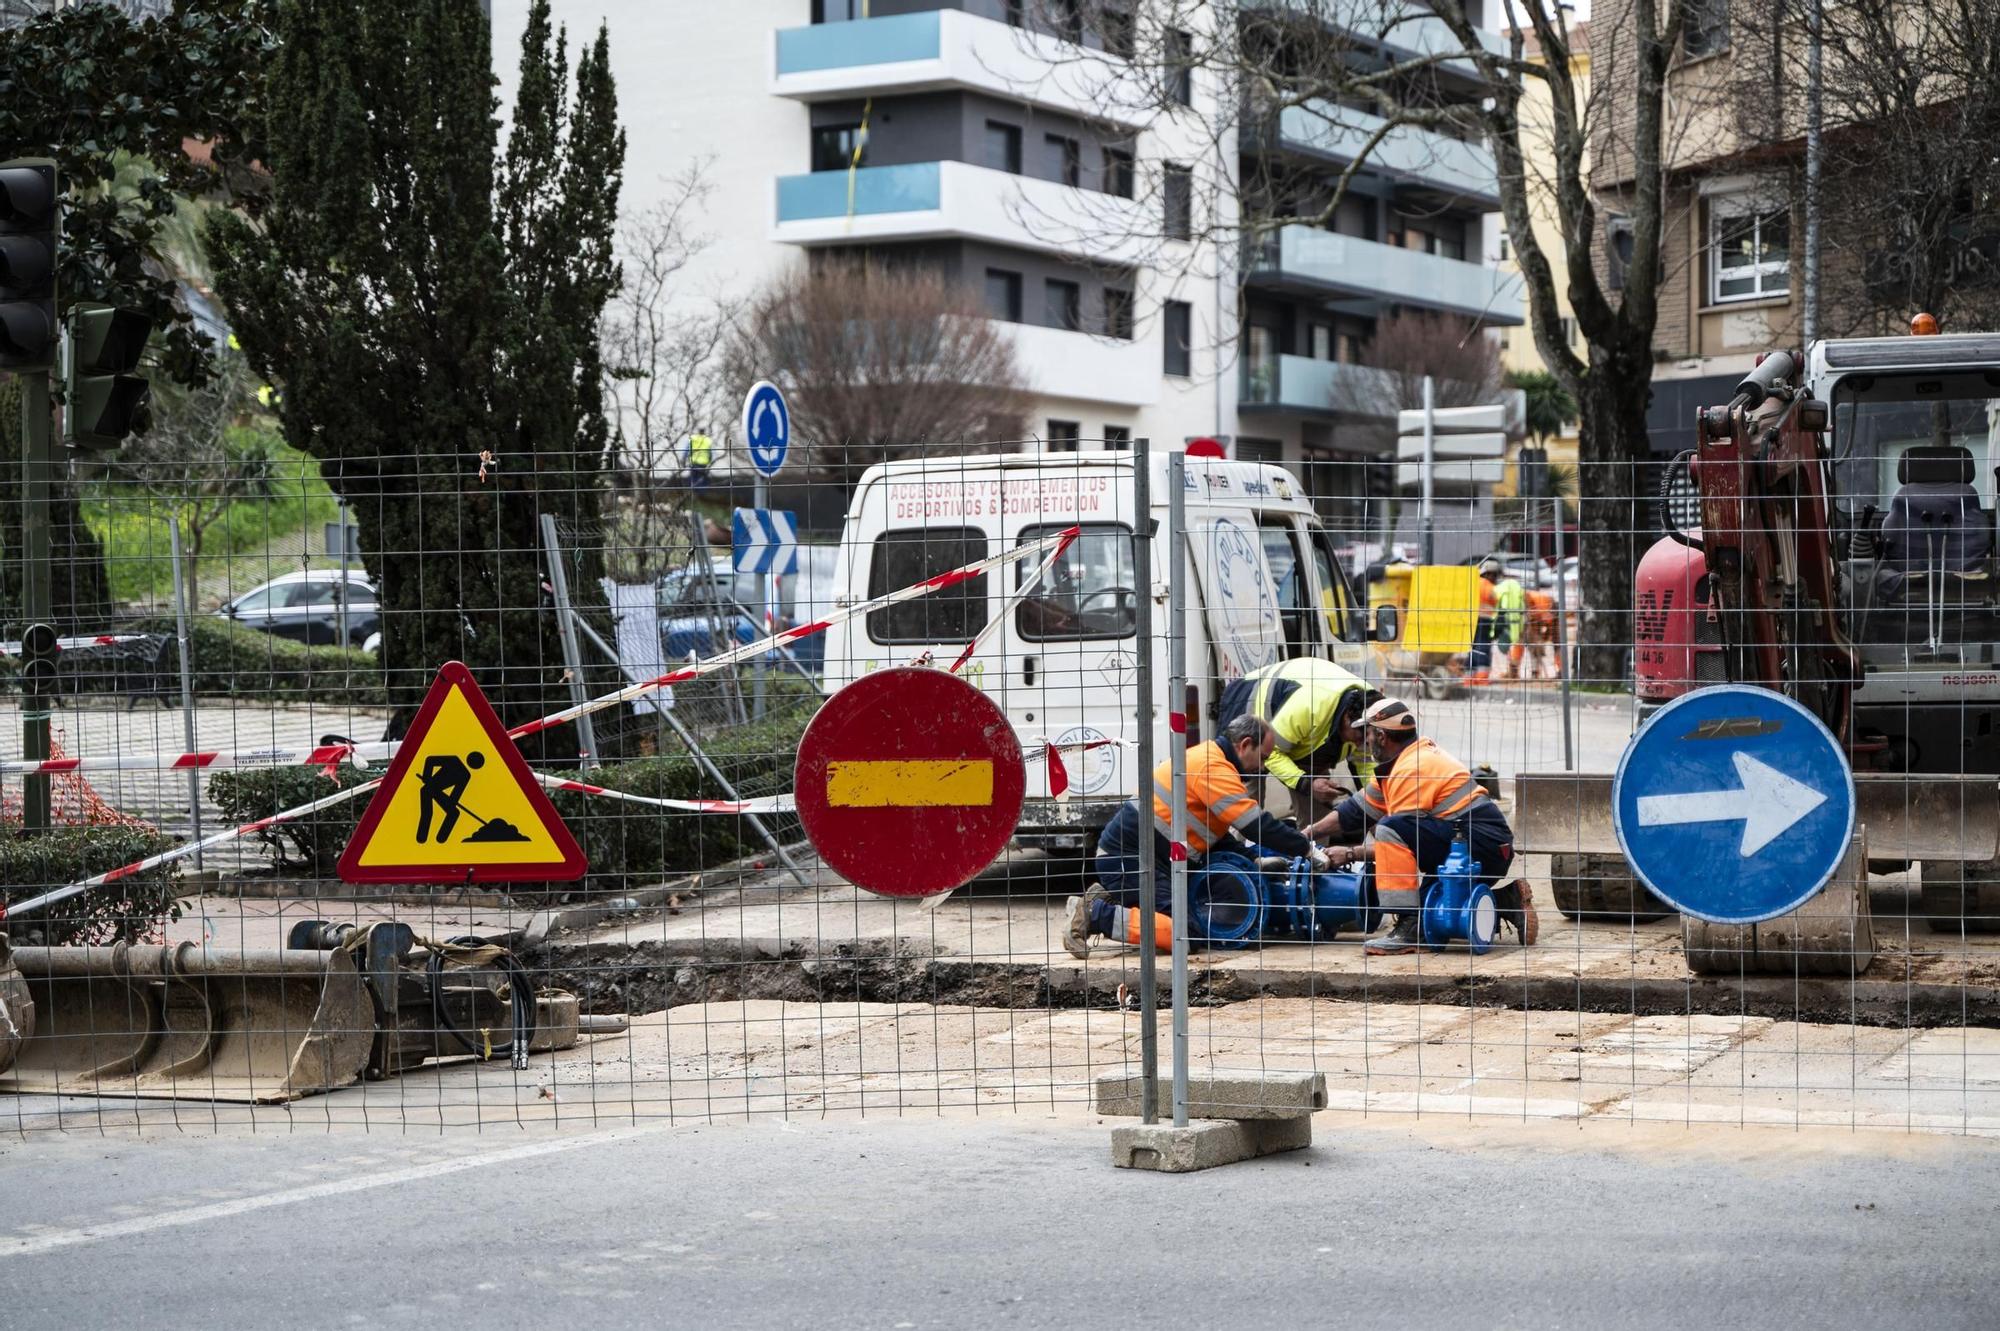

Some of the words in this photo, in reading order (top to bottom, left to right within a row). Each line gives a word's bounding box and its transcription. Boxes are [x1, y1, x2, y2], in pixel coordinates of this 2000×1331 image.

[891, 483, 975, 500] ACCESORIOS
[990, 477, 1107, 497] COMPLEMENTOS
[897, 499, 982, 518] DEPORTIVOS
[1001, 495, 1099, 514] COMPETICION
